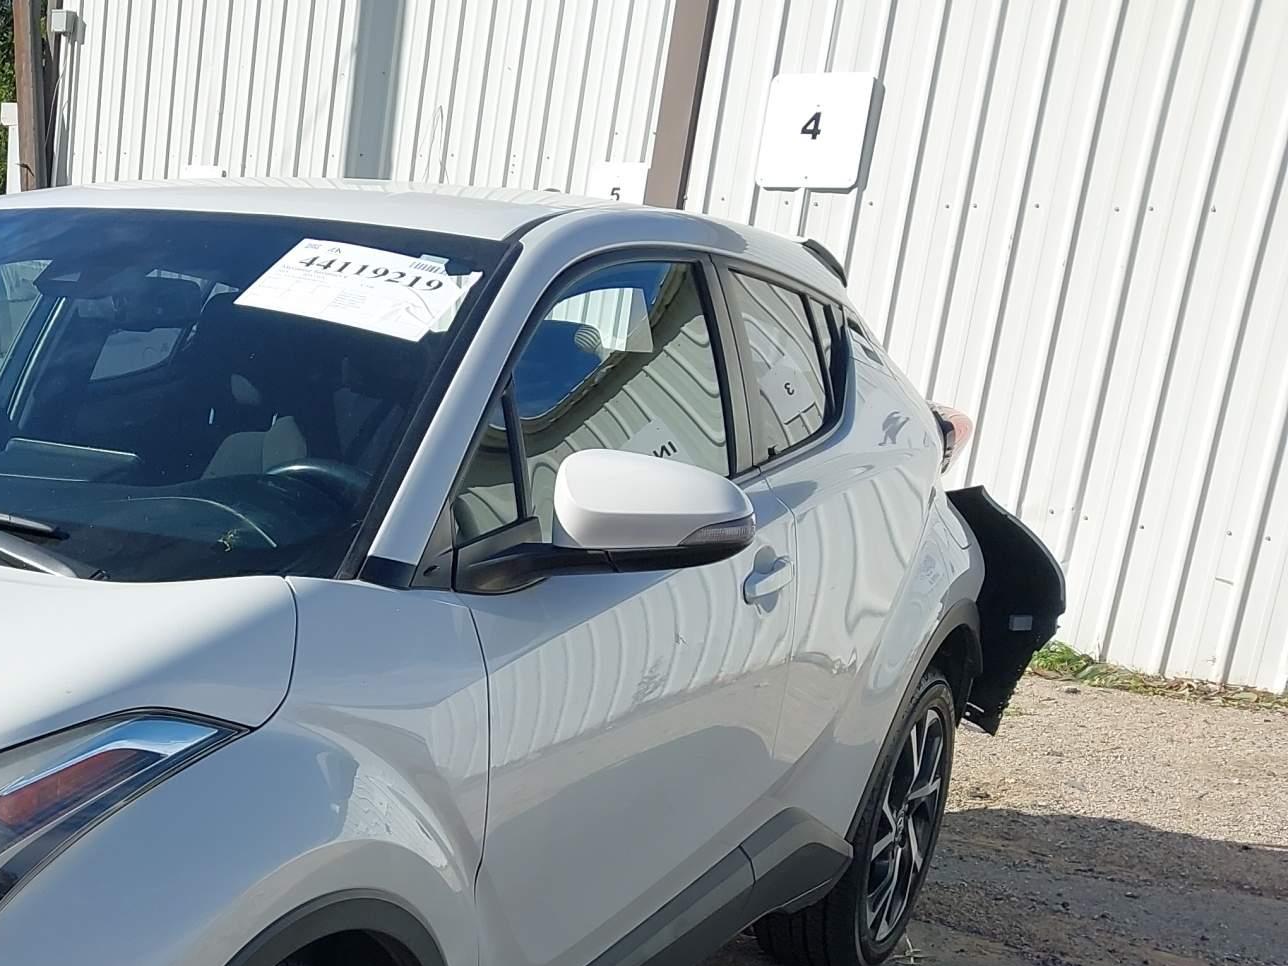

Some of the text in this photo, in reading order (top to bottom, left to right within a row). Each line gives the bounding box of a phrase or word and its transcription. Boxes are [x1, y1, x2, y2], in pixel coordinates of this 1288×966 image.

[800, 111, 822, 140] 4
[610, 187, 621, 201] 5
[298, 254, 444, 292] 44119219
